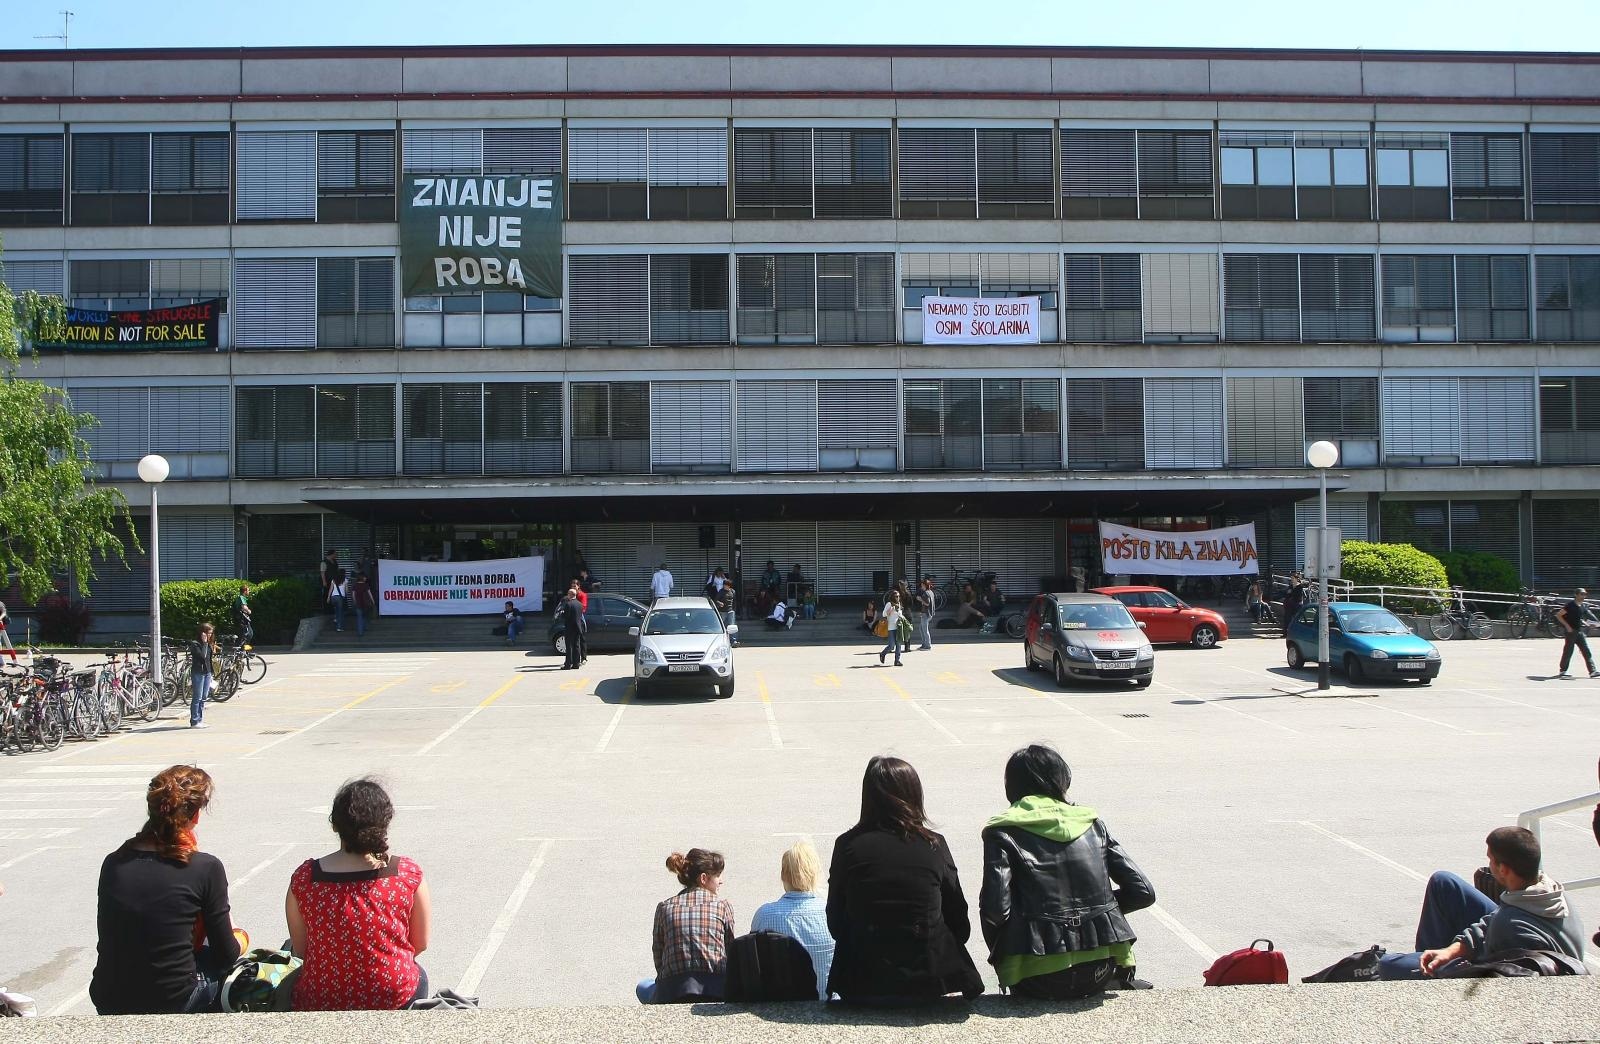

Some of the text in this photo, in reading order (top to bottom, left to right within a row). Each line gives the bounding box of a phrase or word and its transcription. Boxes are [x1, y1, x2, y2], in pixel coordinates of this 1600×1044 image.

[412, 178, 553, 209] ZNANJE
[438, 215, 522, 248] NIJE
[434, 256, 527, 289] ROBA
[146, 304, 212, 323] STRUGGLE
[927, 301, 1030, 317] NEMAMO ŠTO IZGUBITI
[104, 326, 115, 341] IS
[118, 326, 143, 342] NOT
[145, 325, 170, 341] FOR
[173, 323, 206, 341] SALE
[935, 319, 1030, 336] OSIM ŠKOLARINA
[1102, 532, 1150, 560] POŠTO
[1155, 539, 1194, 561] KILA
[393, 573, 516, 586] JEDAN SVIJET JEDNA BORBA
[383, 587, 526, 601] OBRAZOVANJE NIJE NA PRODAJU
